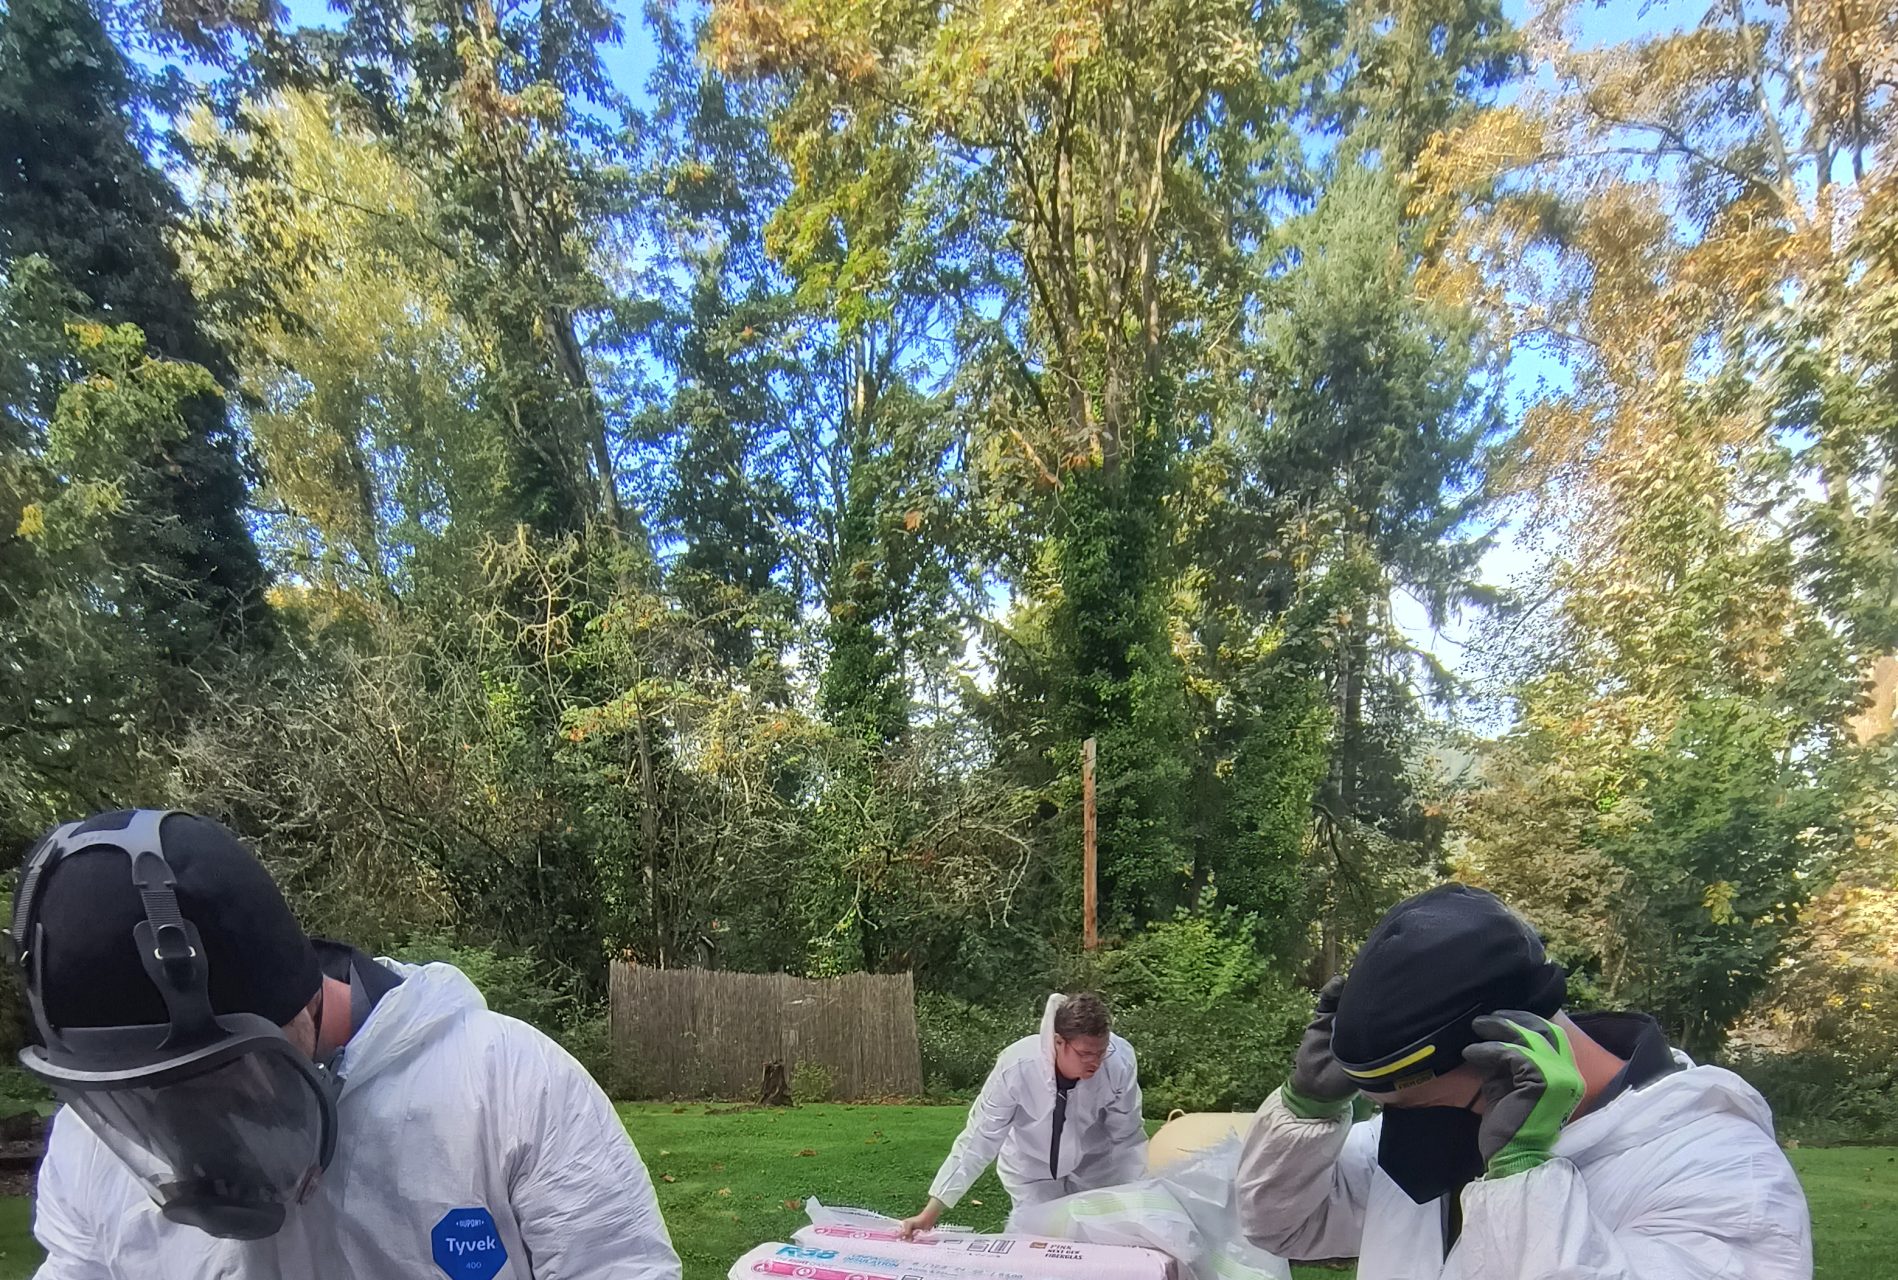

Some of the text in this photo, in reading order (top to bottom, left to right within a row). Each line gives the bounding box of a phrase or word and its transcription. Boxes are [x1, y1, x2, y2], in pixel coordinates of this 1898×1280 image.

[445, 1235, 496, 1256] Tyvek
[776, 1246, 839, 1259] R38
[465, 1261, 482, 1270] 400
